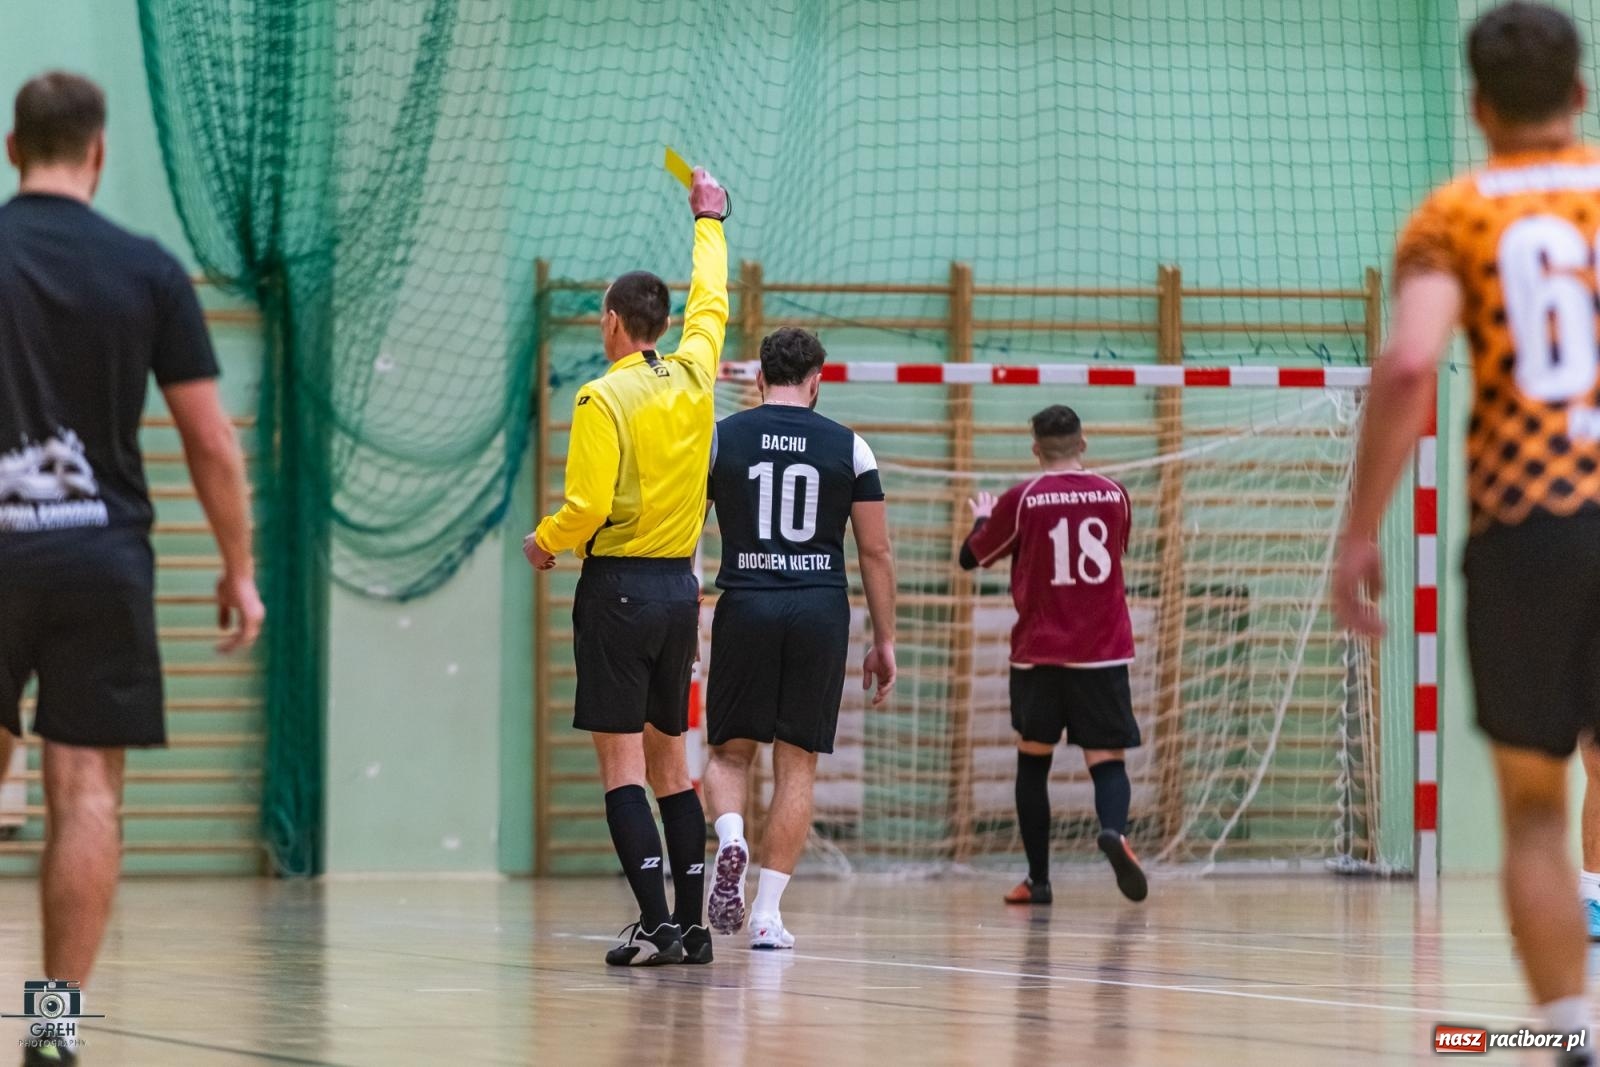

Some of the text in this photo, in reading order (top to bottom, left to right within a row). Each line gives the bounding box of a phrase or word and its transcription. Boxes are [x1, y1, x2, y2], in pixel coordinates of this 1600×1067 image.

[1499, 214, 1600, 400] 6
[761, 433, 807, 452] BACHU
[748, 461, 820, 542] 10
[738, 552, 831, 570] BIOCHEM KIETRZ
[1048, 517, 1112, 586] 18
